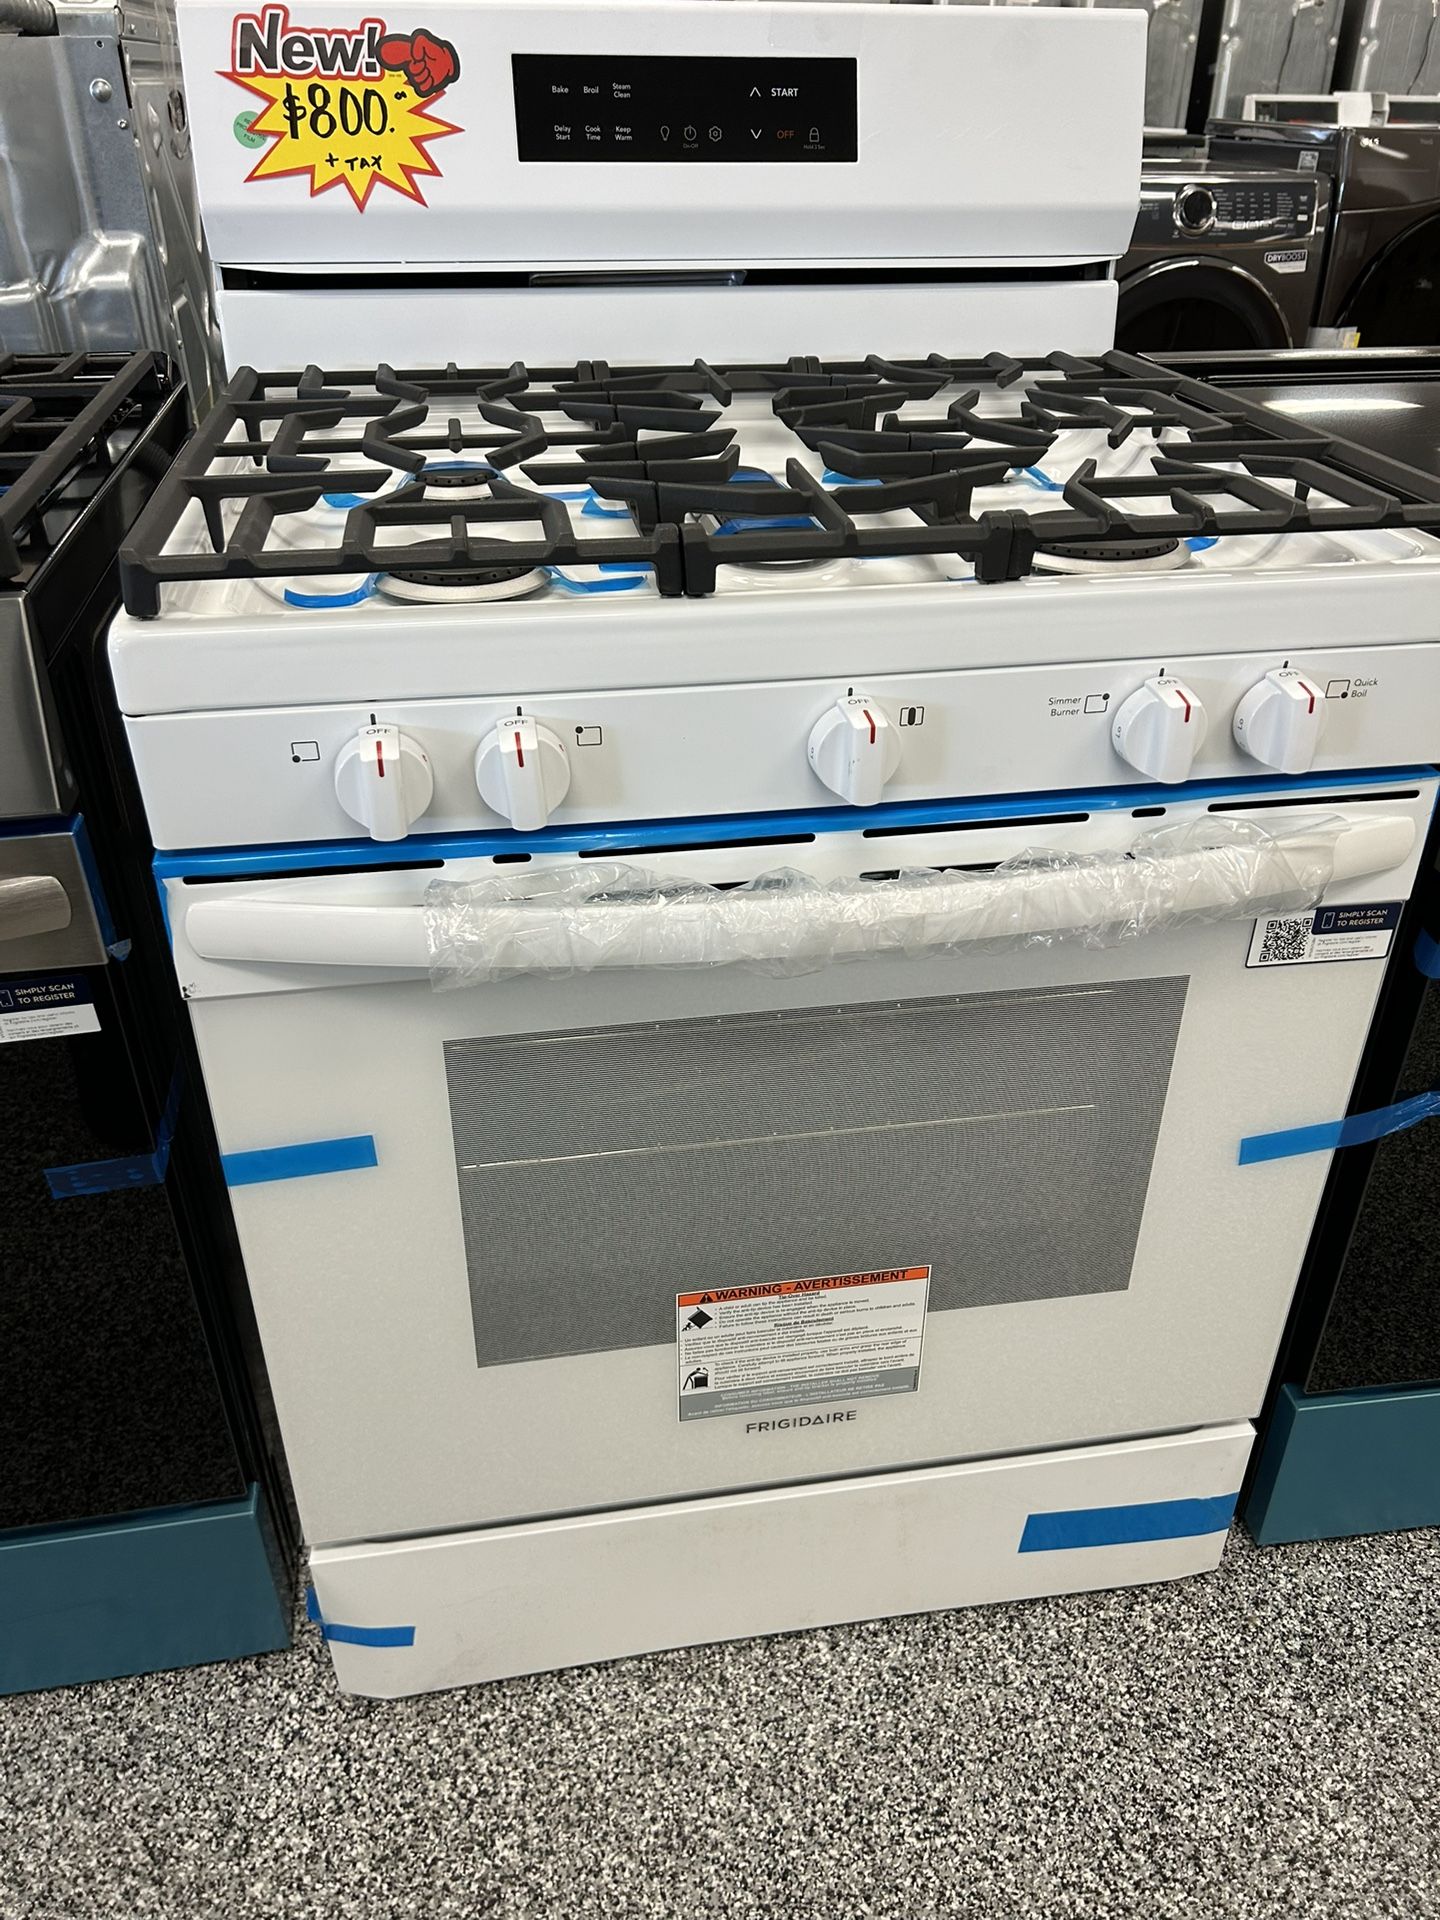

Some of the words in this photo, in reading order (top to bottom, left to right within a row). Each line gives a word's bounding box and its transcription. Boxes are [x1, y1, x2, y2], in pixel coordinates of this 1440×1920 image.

[239, 13, 379, 73] New!
[551, 85, 569, 94] Bake
[583, 85, 599, 94] Broil
[612, 83, 631, 91] Steam
[771, 88, 799, 97] START
[554, 125, 571, 134] Delay
[585, 125, 600, 133] Cook
[615, 126, 631, 134] Keep
[555, 133, 571, 141] Start
[586, 133, 601, 141] Time
[615, 133, 632, 141] Warm
[777, 130, 795, 139] OFF
[325, 152, 339, 167] +
[344, 154, 382, 171] TAX
[1351, 690, 1367, 698] Boil
[1048, 697, 1081, 705] Simmer
[1050, 709, 1080, 717] Burner
[366, 727, 392, 735] OFF
[1338, 910, 1365, 919] SIMPLY
[1366, 909, 1388, 917] SCAN
[1349, 917, 1384, 926] REGISTER
[15, 986, 46, 996] SIMPLY
[48, 983, 75, 992] SCAN
[33, 991, 75, 1003] REGISTER
[716, 1284, 781, 1300] WARNING
[794, 1270, 909, 1292] AVERTISSEMENT
[746, 1410, 857, 1433] FRIGIDAIRE
